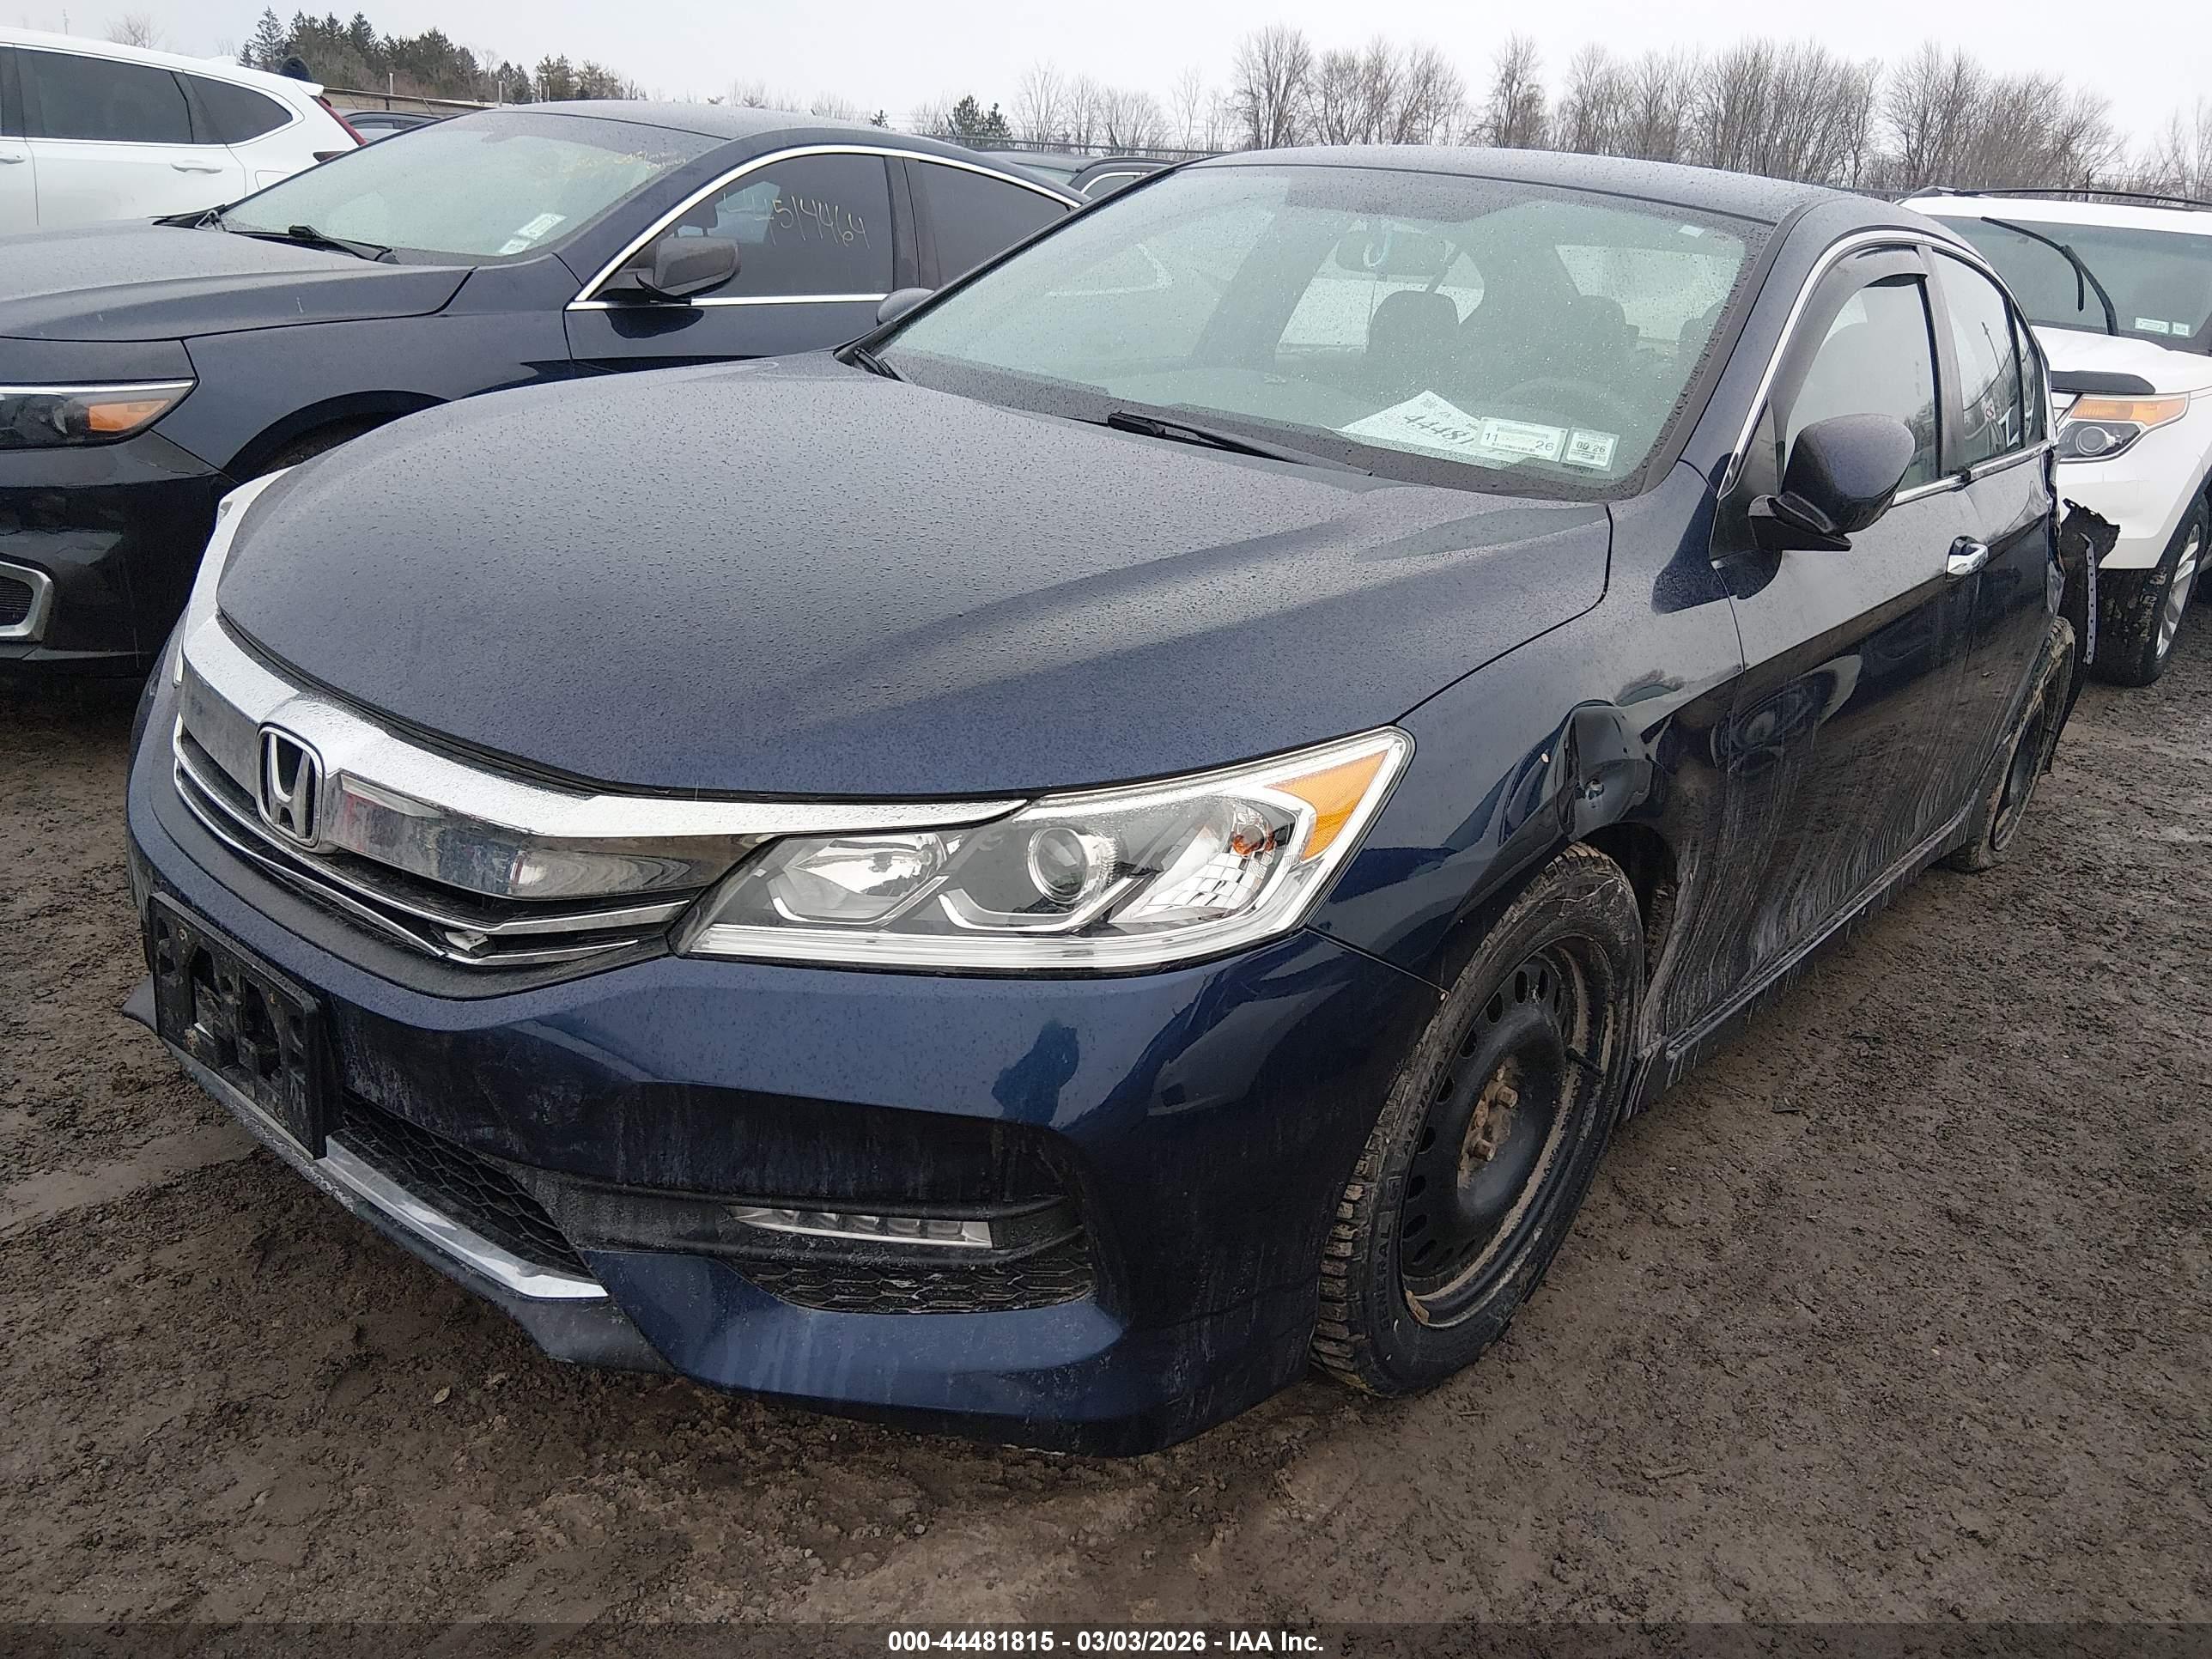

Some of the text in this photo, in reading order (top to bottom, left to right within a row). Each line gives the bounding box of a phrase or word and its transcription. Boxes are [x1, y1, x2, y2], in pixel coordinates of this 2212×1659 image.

[1485, 432, 1498, 442] 11
[1534, 440, 1555, 452] 26
[1592, 444, 1607, 453] 26
